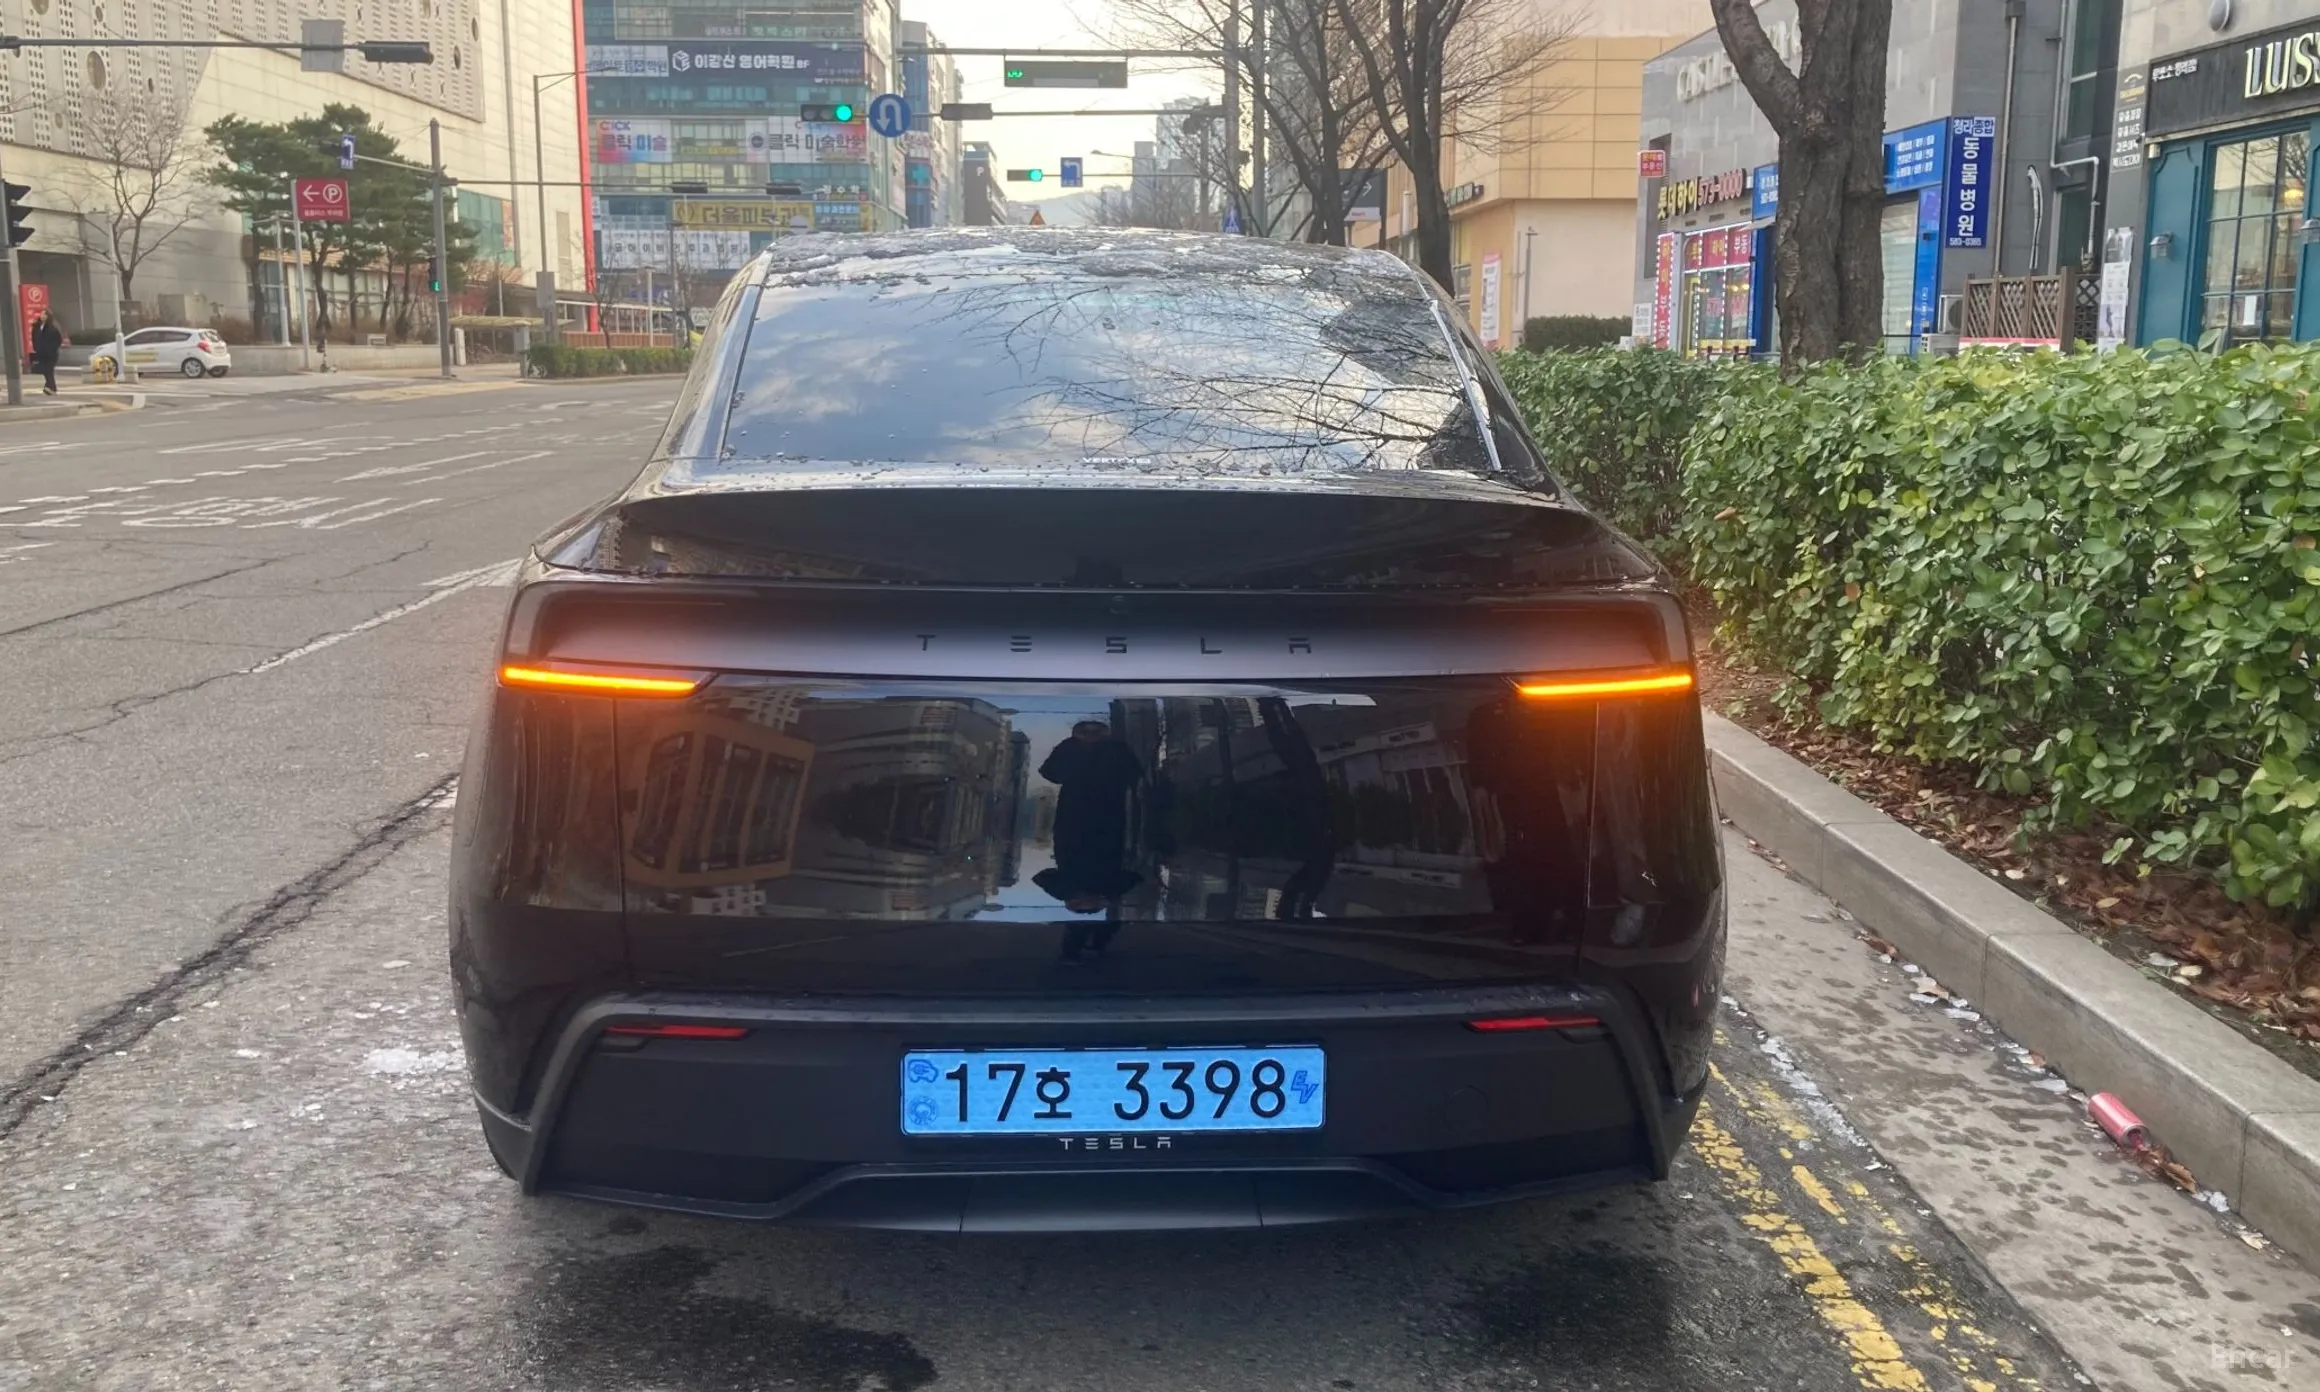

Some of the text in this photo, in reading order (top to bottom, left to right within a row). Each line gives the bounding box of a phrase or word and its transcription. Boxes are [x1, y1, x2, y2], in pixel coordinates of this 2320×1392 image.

[2244, 32, 2320, 98] LUS
[769, 134, 799, 150] 클릭
[1957, 137, 1980, 237] 동물병원
[916, 634, 1312, 655] TESLA
[945, 1059, 1287, 1122] 17호 3398
[1291, 1070, 1320, 1104] EV
[1059, 1136, 1172, 1150] TESLA
